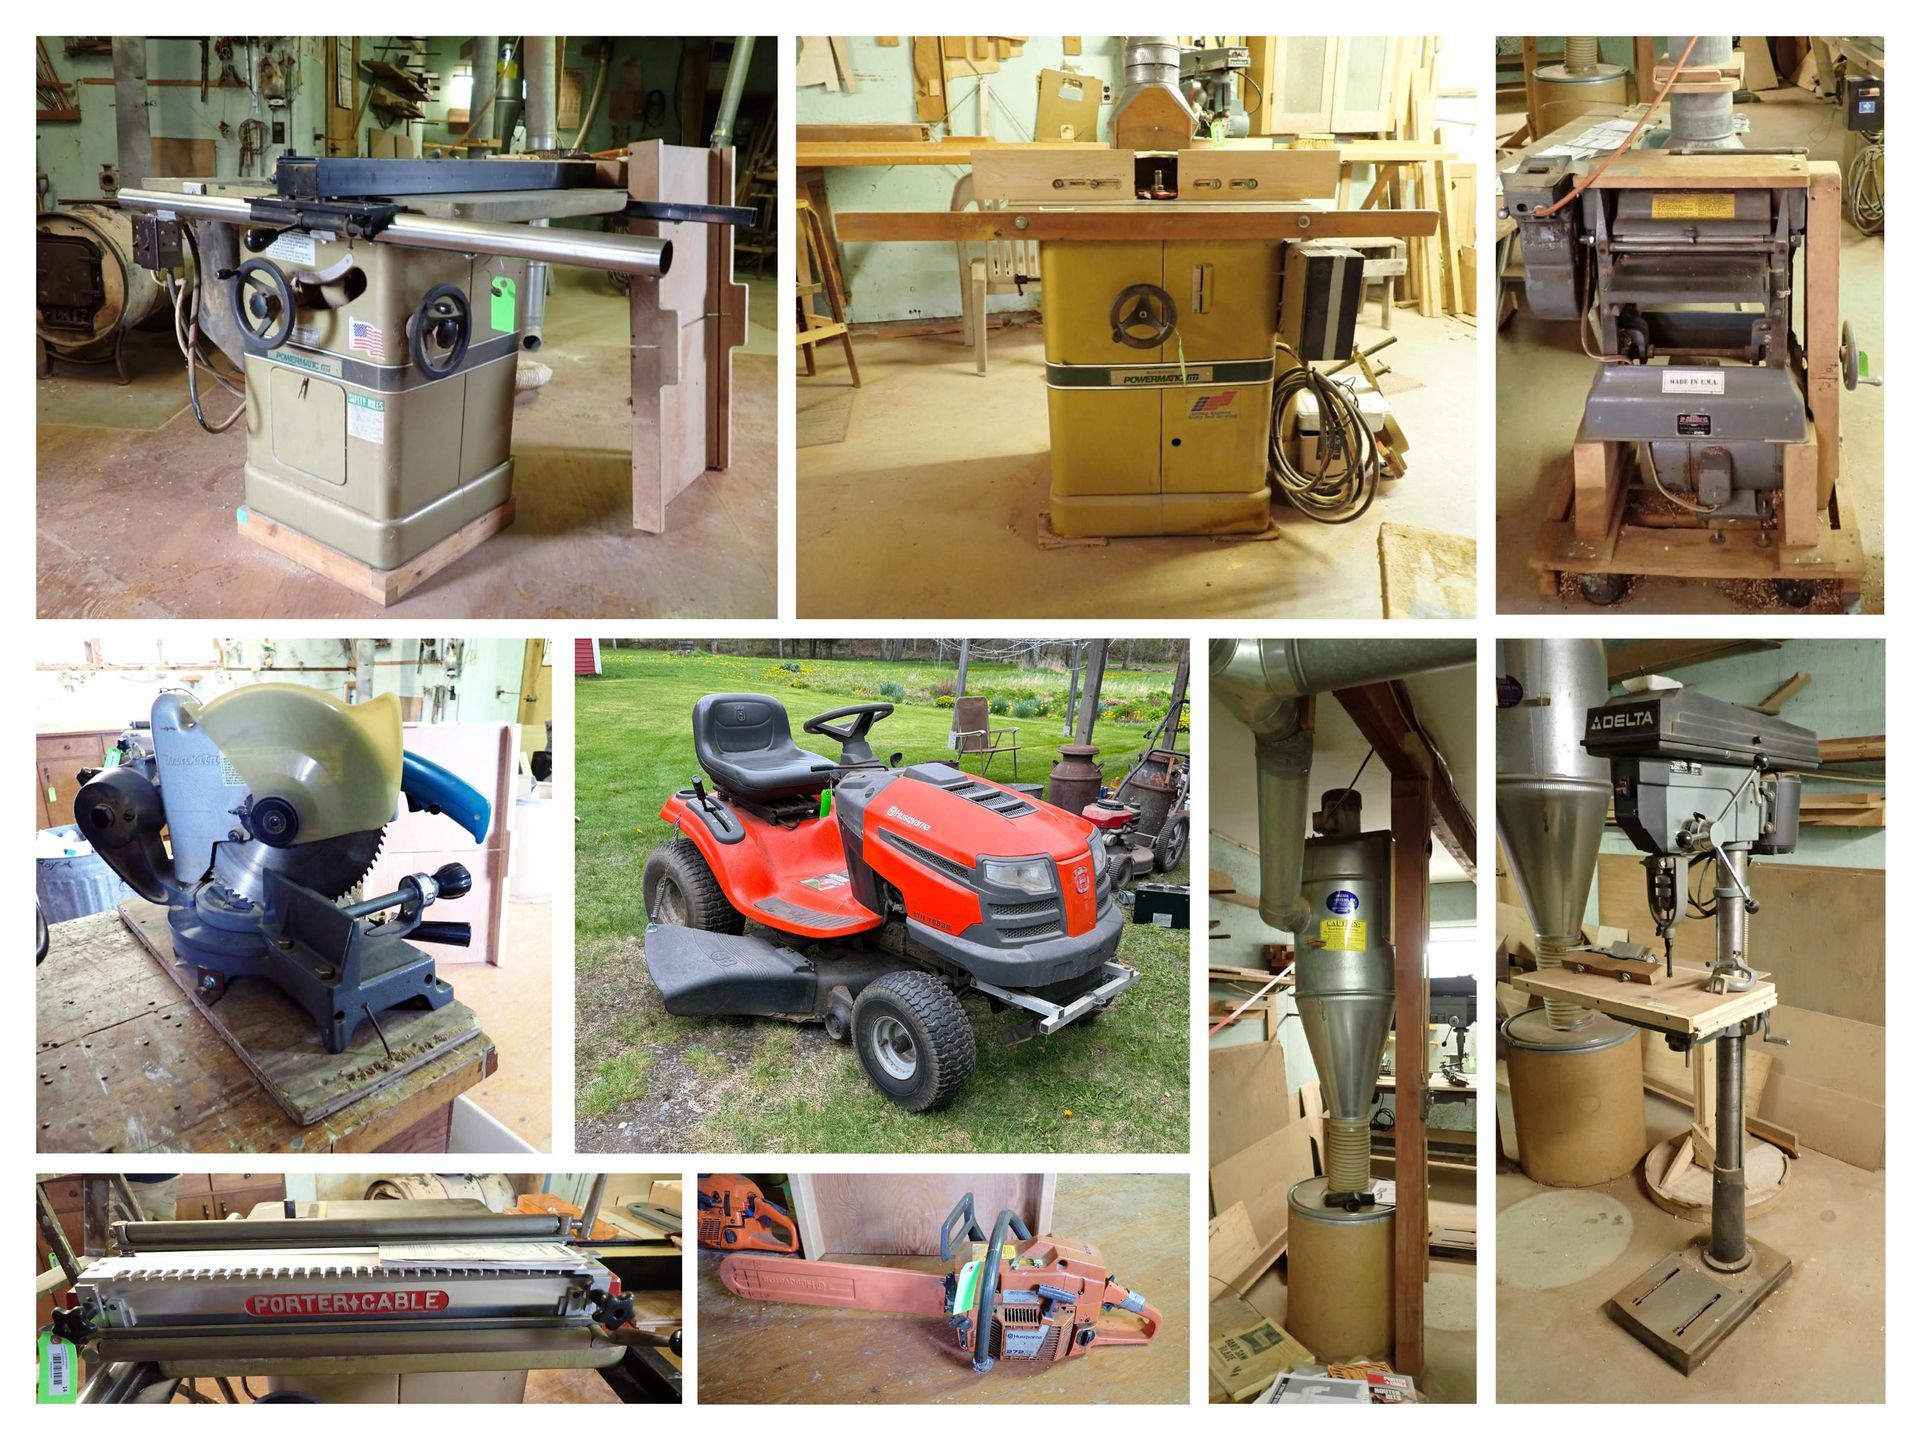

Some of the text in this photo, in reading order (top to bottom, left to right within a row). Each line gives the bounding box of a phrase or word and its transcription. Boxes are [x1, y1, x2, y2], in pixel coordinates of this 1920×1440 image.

[276, 352, 319, 369] POWERMATIC
[1124, 374, 1186, 384] POWERMATIC
[1602, 711, 1654, 729] DELTA
[894, 808, 932, 832] Husqvarna
[1326, 920, 1361, 928] CAUTIN:
[254, 1291, 441, 1314] PORTER CABLE
